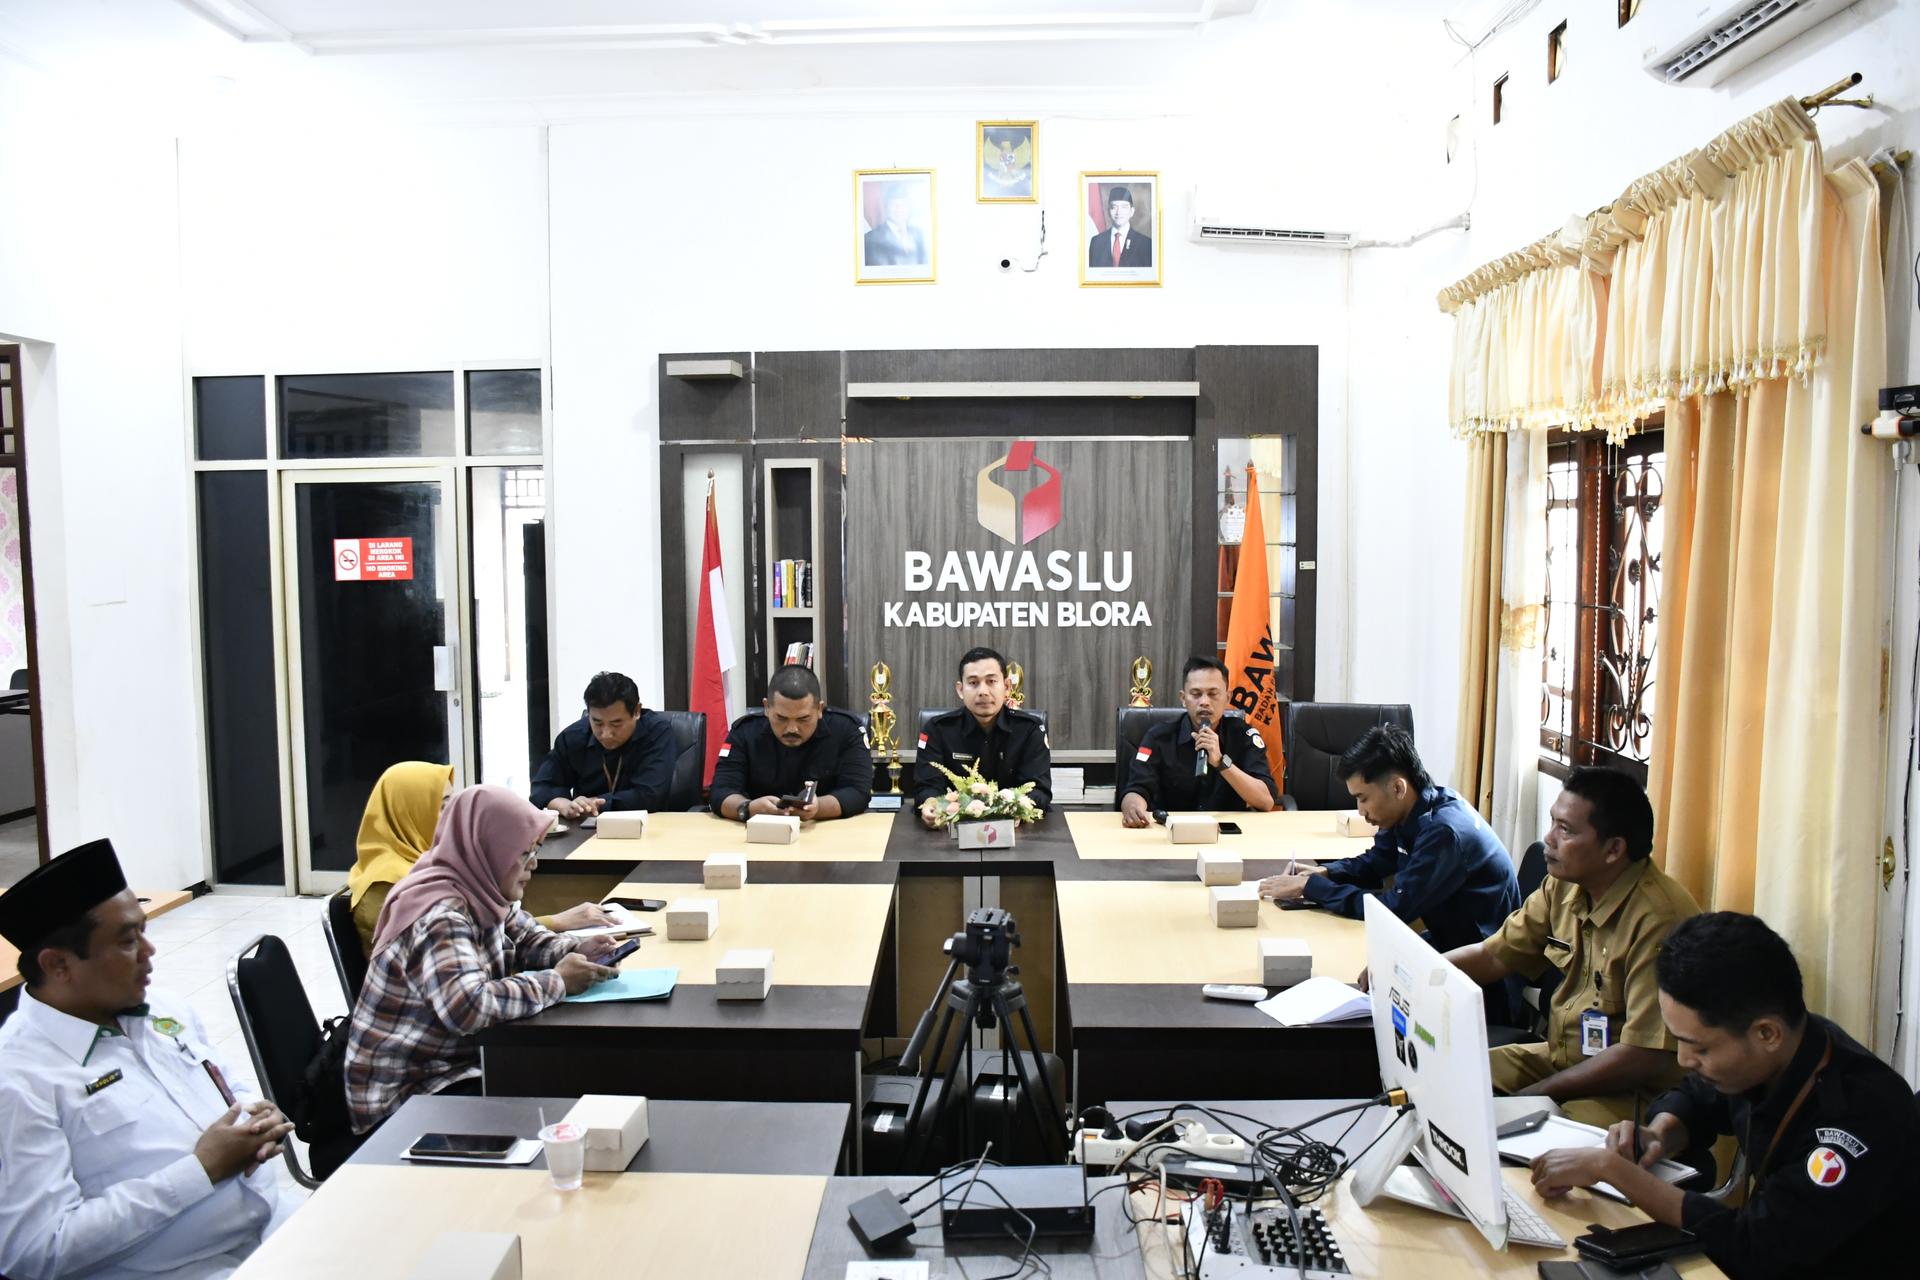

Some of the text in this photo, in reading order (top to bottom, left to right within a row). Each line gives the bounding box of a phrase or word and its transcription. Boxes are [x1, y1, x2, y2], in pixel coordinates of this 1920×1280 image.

[904, 550, 1132, 592] BAWASLU
[884, 601, 1152, 627] KABUPATEN BLORA
[1824, 1130, 1859, 1148] BAWASLU
